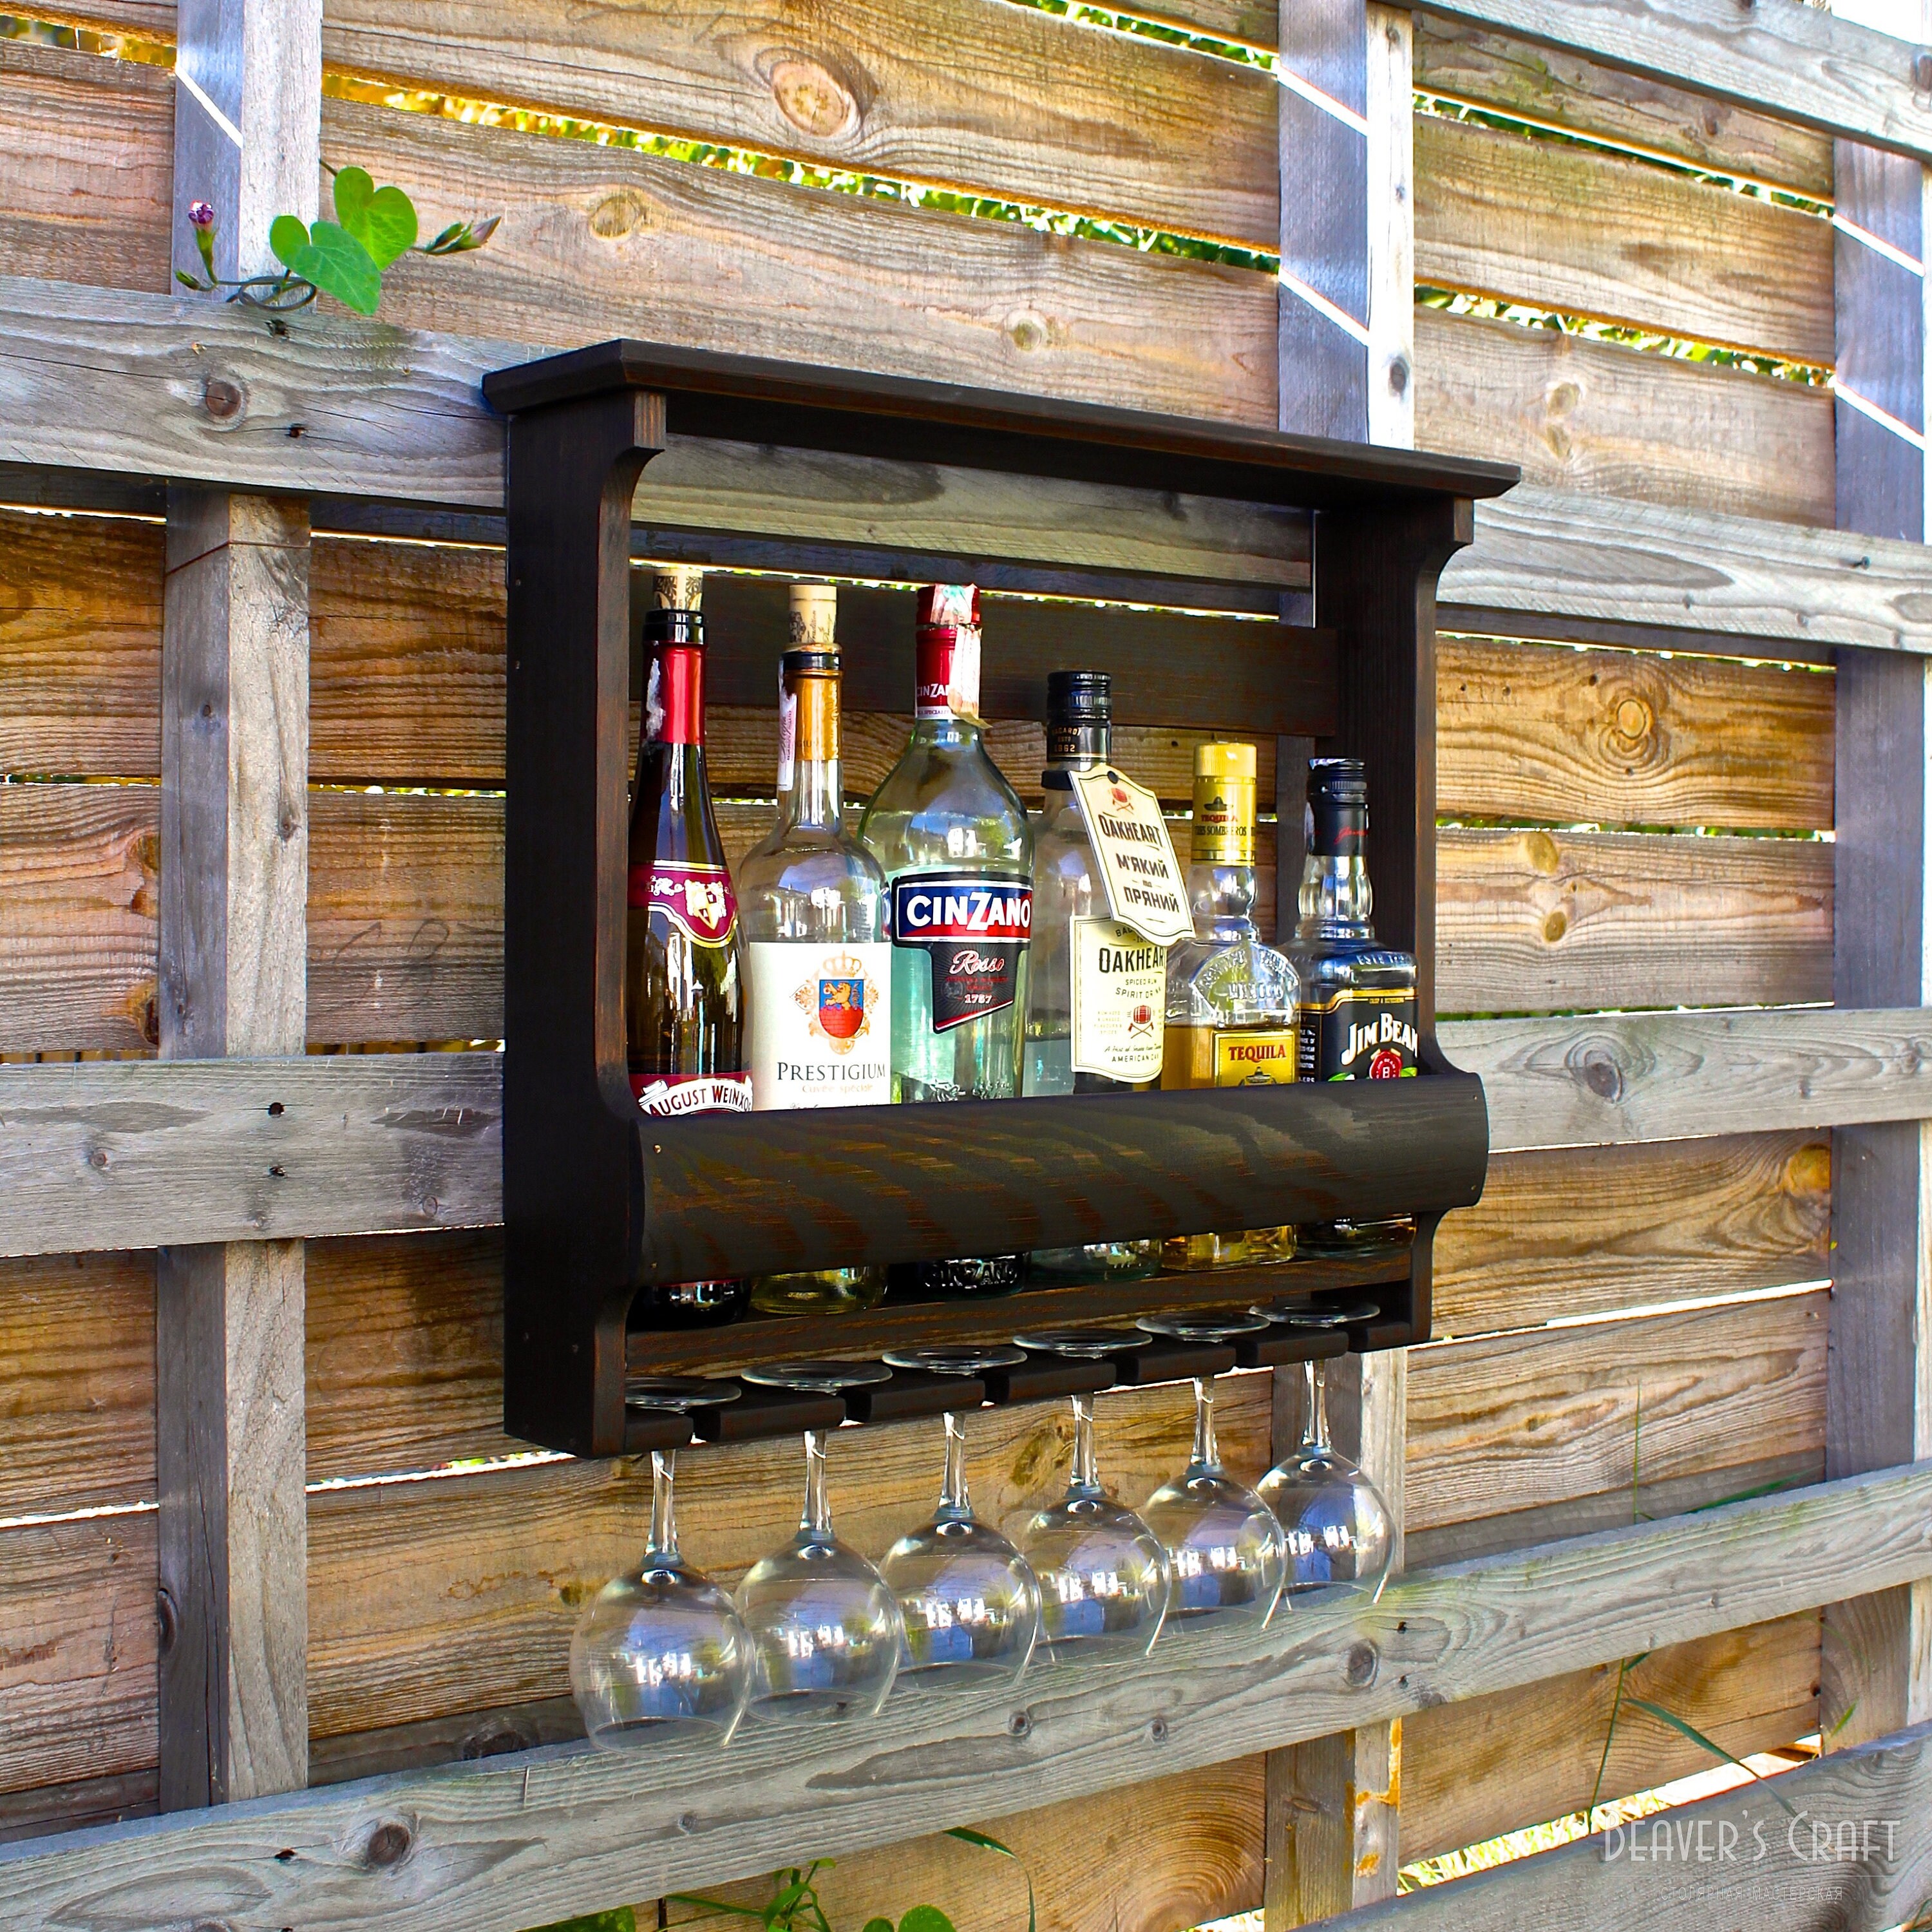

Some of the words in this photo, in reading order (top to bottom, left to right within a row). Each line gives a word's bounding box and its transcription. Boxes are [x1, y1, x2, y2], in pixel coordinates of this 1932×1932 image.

[1098, 813, 1163, 848] OAKHEART
[1115, 853, 1170, 879] М'ЯКИЙ
[906, 892, 1031, 931] CINZANO
[1123, 886, 1180, 913] ПРЯНИЙ
[949, 950, 1005, 975] Rosso
[1115, 987, 1143, 999] SPIRIT
[1227, 1044, 1287, 1062] TEQUILA
[1341, 1023, 1379, 1066] JIM
[777, 1062, 886, 1081] PRESTIGIUM
[649, 1088, 707, 1116] AUGUST
